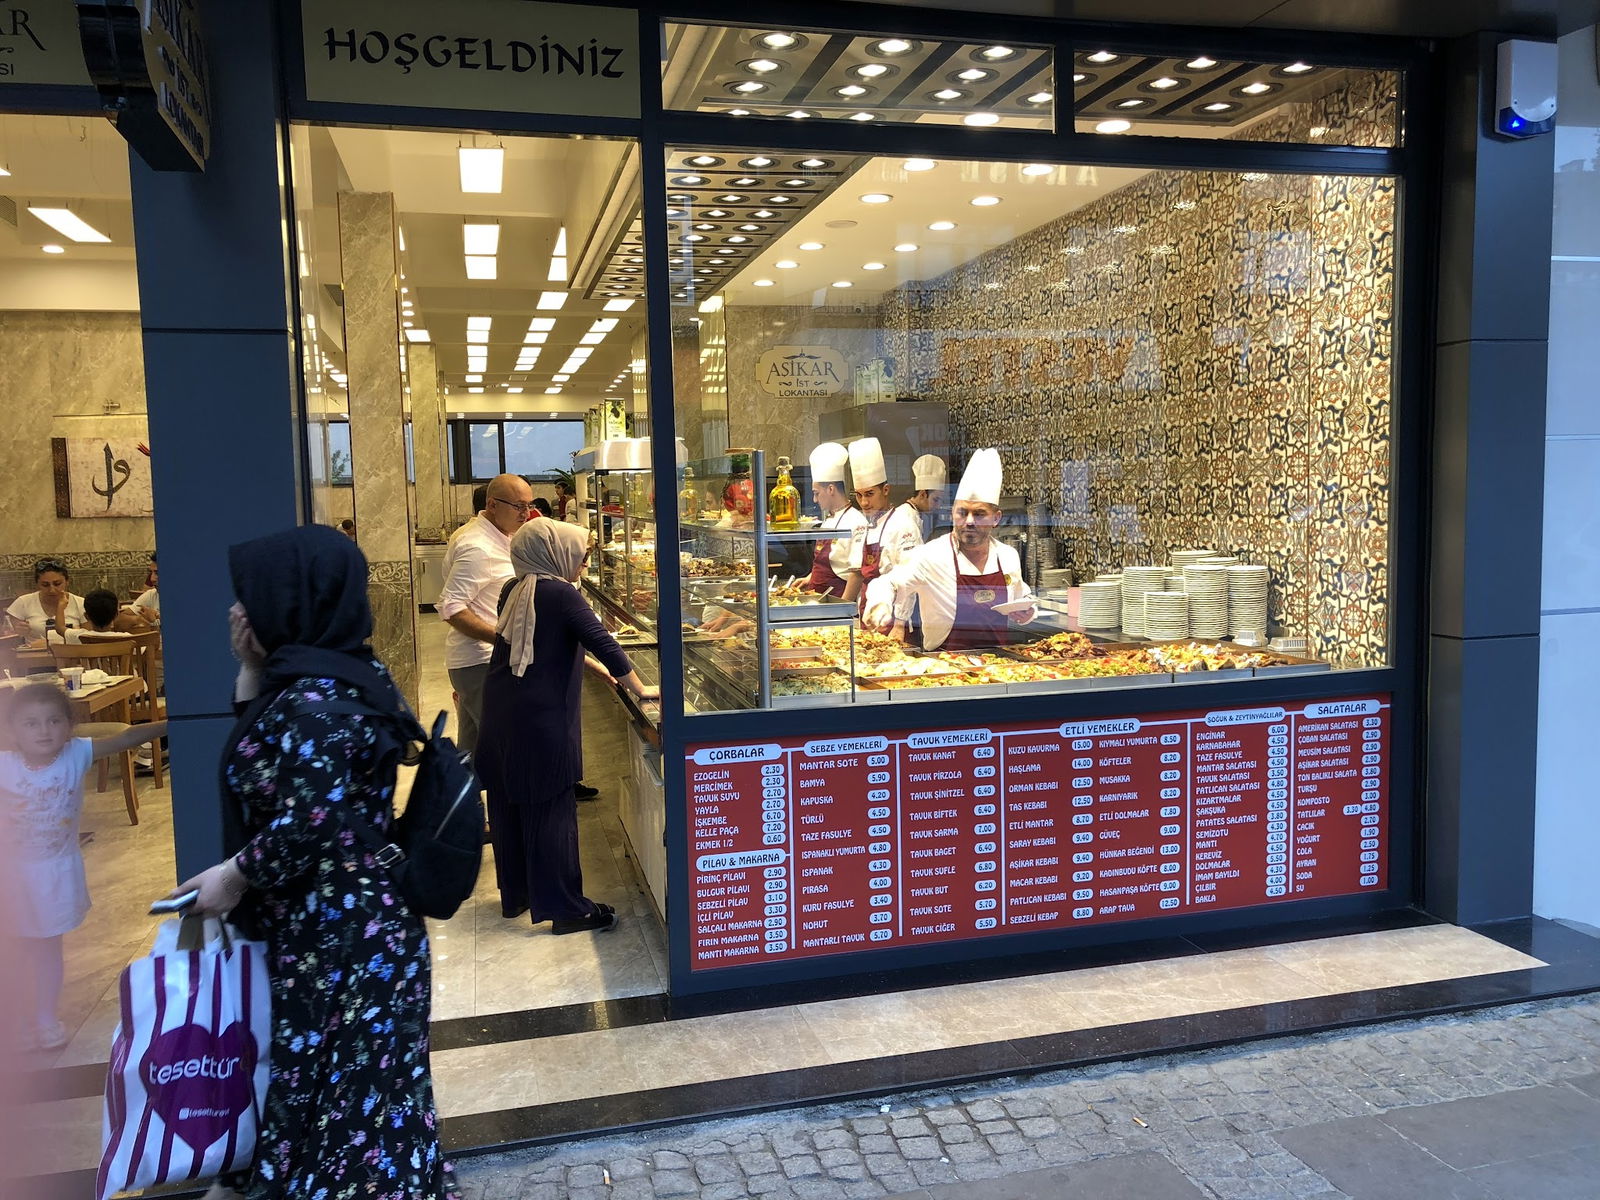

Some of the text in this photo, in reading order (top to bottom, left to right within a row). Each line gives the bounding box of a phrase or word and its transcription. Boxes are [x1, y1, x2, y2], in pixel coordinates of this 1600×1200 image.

[324, 27, 624, 78] HOŞGELDİNİZ
[766, 360, 840, 384] AŞİKAR
[1317, 702, 1366, 715] SALATALAR
[1065, 722, 1134, 735] ETLİ YEMEKLER
[911, 732, 987, 745] TAVUK YEMEKLERİ
[810, 740, 881, 753] SEBZE YEMEKLERİ
[709, 747, 764, 761] ÇORBALAR
[908, 751, 955, 761] TAVUK KANAT
[977, 748, 990, 756] 6.40
[799, 758, 857, 770] MANTAR SOTE
[871, 756, 885, 764] 5.00
[1074, 759, 1090, 767] 14.00
[765, 765, 780, 774] 2.30
[977, 767, 991, 775] 6.40
[1008, 763, 1040, 773] HAŞLAMA
[694, 770, 729, 780] EZOGELİN
[871, 773, 886, 781] 5.90
[908, 770, 961, 781] TAVUK PİRZOLA
[765, 777, 781, 785] 2.30
[800, 778, 824, 787] BAMYA
[1074, 778, 1090, 786] 12.50
[694, 781, 732, 792] MERCİMEK
[977, 786, 991, 794] 6.40
[1008, 781, 1057, 792] ORMAN KEBABI
[766, 788, 781, 797] 2.70
[910, 791, 932, 799] TAVUK
[694, 792, 739, 803] TAVUK SUYU
[800, 795, 832, 805] KAPUSKA
[766, 800, 781, 808] 2.70
[695, 805, 718, 814] YAYLA
[871, 808, 886, 816] 4.50
[977, 805, 991, 813] 6.40
[766, 811, 781, 820] 6.70
[801, 813, 823, 823] TÜRLÜ
[909, 809, 956, 820] TAVUK BİFTEK
[695, 816, 726, 827] İŞKEMBE
[766, 822, 781, 831] 7.20
[695, 826, 738, 837] KELLE PAÇA
[801, 829, 851, 840] TAZE FASULYE
[766, 834, 782, 843] 0.60
[695, 840, 720, 849] EKMEK
[702, 853, 779, 869] PİLAV & MAKARNA
[872, 861, 887, 869] 4.30
[1035, 857, 1058, 865] KEBABI
[767, 868, 782, 876] 2.90
[802, 866, 832, 876] ISPANAK
[696, 872, 745, 883] PİRİNÇ PİLAVI
[873, 878, 887, 886] 4.00
[768, 880, 783, 889] 2.90
[802, 884, 828, 894] PIRASA
[978, 881, 992, 889] 6.20
[697, 885, 749, 897] BULGUR PİLAVI
[910, 885, 948, 896] TAVUK BUT
[1076, 890, 1089, 898] 9.50
[767, 893, 783, 901] 3.10
[873, 895, 888, 904] 3.40
[1010, 892, 1066, 905] PATLICAN KEBABI
[697, 897, 747, 910] SEBZELİ PİLAV
[802, 899, 853, 912] KURU FASULYE
[979, 900, 992, 908] 5.70
[768, 905, 783, 914] 3.30
[910, 904, 951, 915] TAVUK SOTE
[1076, 908, 1089, 917] 8.80
[713, 911, 733, 919] PİLAV
[873, 913, 887, 921] 3.70
[1010, 911, 1058, 923] SEBZELİ KEBAP
[698, 919, 761, 933] SALÇALI MAKARNA
[768, 918, 782, 926] 2.90
[803, 919, 827, 929] NOHUT
[979, 919, 993, 927] 5.50
[911, 922, 954, 934] TAVUK CİĞER
[768, 930, 783, 939] 3.50
[874, 930, 888, 939] 5.70
[698, 933, 758, 946] FIRIN MAKARNA
[803, 933, 864, 947] MANTARLI TAVUK
